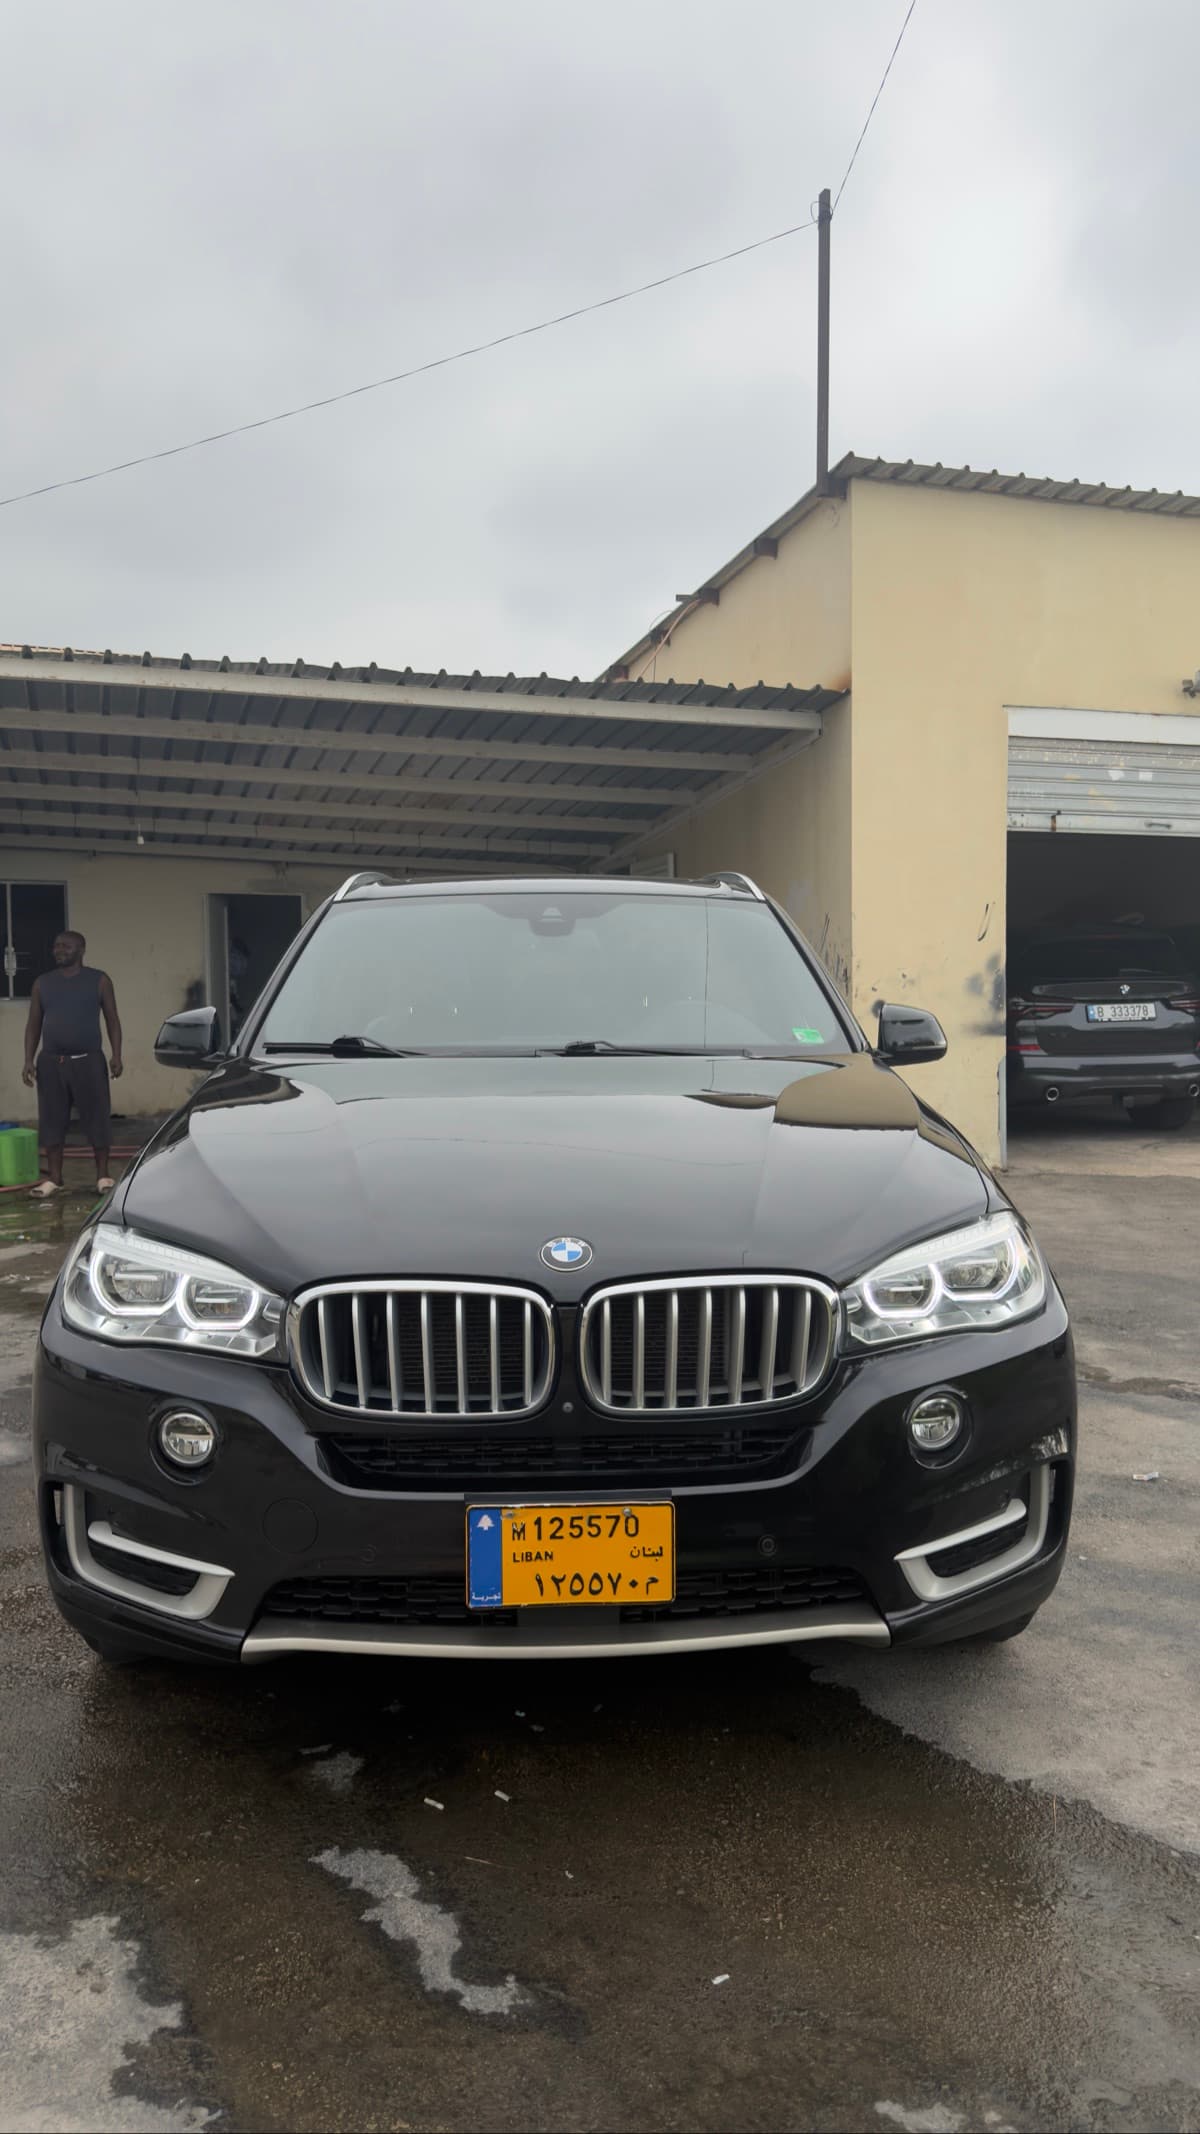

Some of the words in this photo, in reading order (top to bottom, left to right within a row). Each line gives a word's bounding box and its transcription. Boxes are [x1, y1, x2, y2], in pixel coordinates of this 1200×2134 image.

[1097, 1006, 1104, 1018] B
[533, 1514, 640, 1541] 125570
[512, 1551, 554, 1563] LIBAN
[629, 1546, 664, 1561] لبنان
